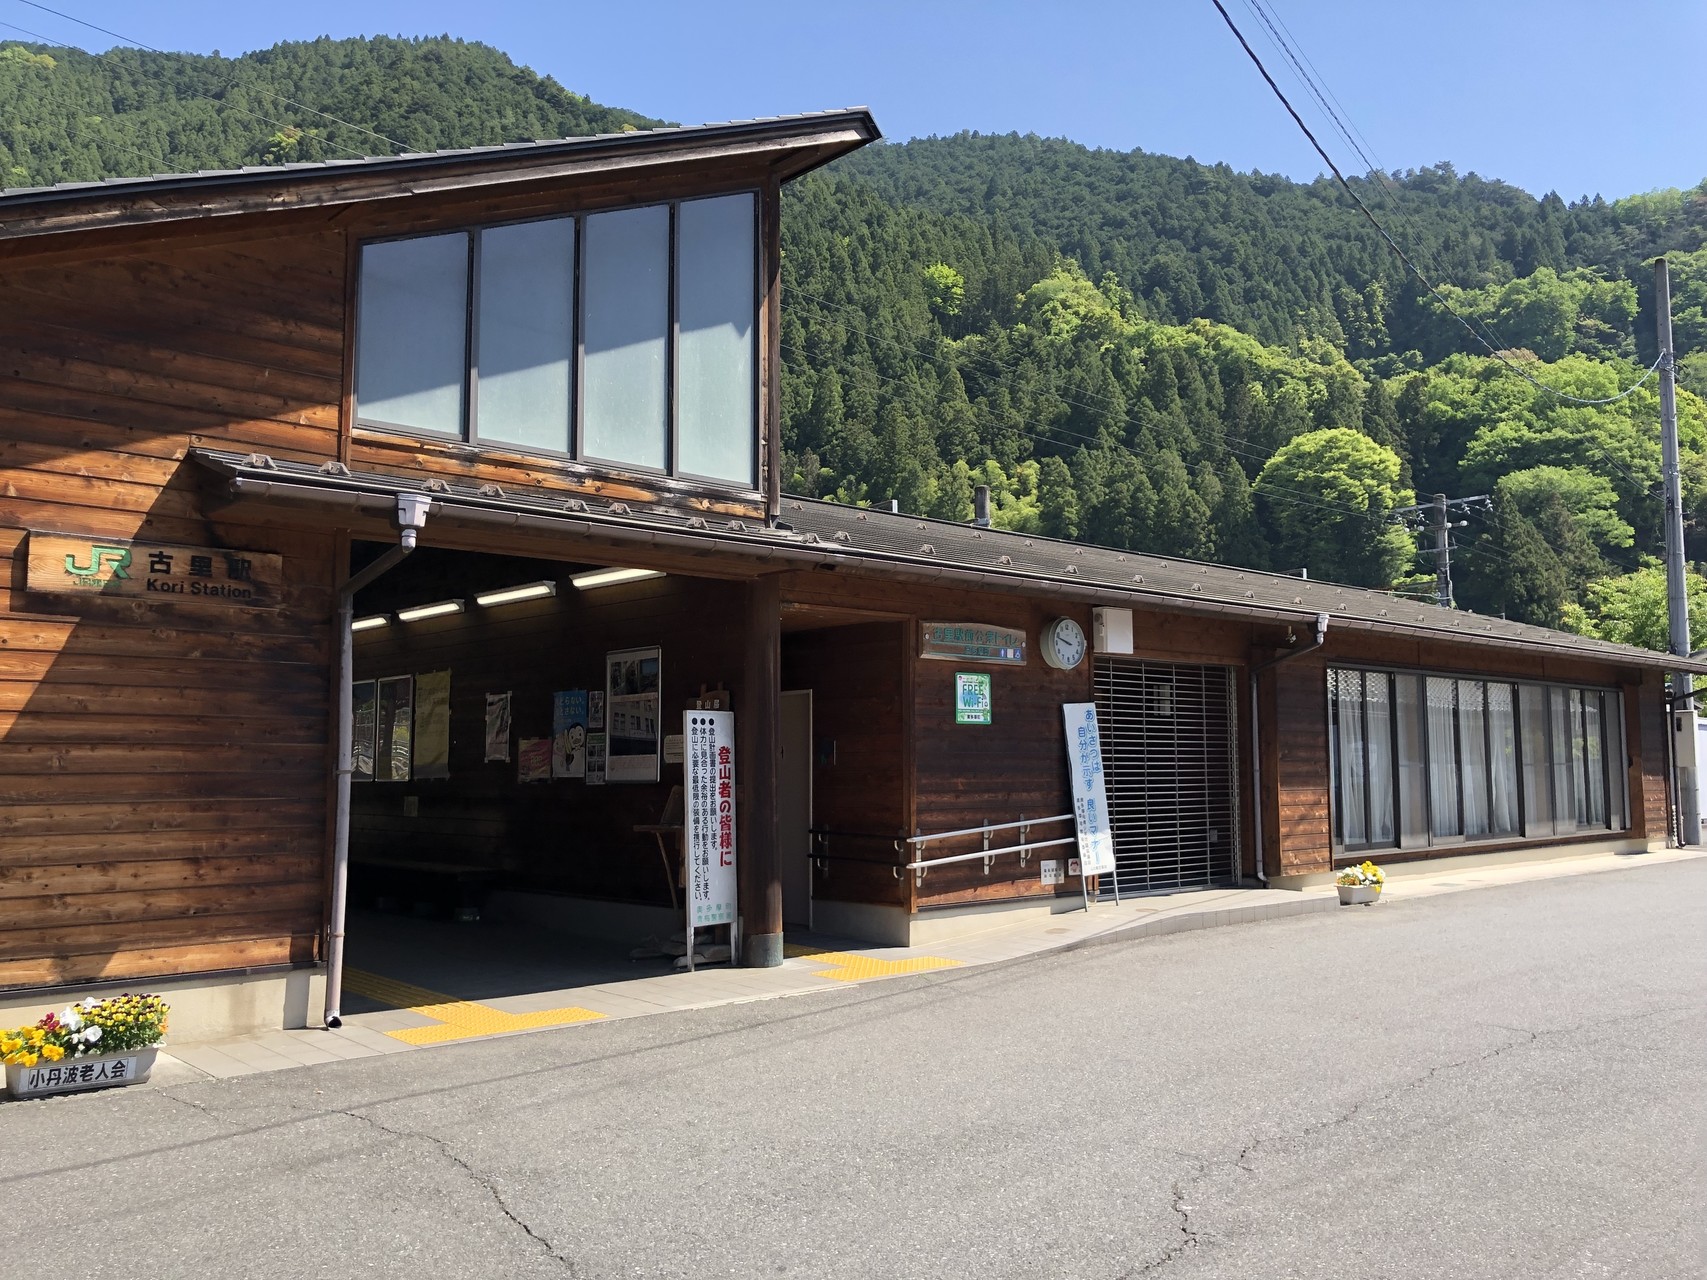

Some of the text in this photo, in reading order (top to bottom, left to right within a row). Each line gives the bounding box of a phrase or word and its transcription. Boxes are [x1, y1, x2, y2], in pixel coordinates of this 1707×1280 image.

[65, 545, 132, 579] JR
[146, 578, 252, 599] Kori Station
[962, 683, 984, 696] FREE
[1085, 708, 1101, 773] あいさつは
[1077, 726, 1093, 792] 自分が示す
[718, 745, 733, 867] 登山者の皆様に
[29, 1059, 126, 1089] 小丹波老人会
